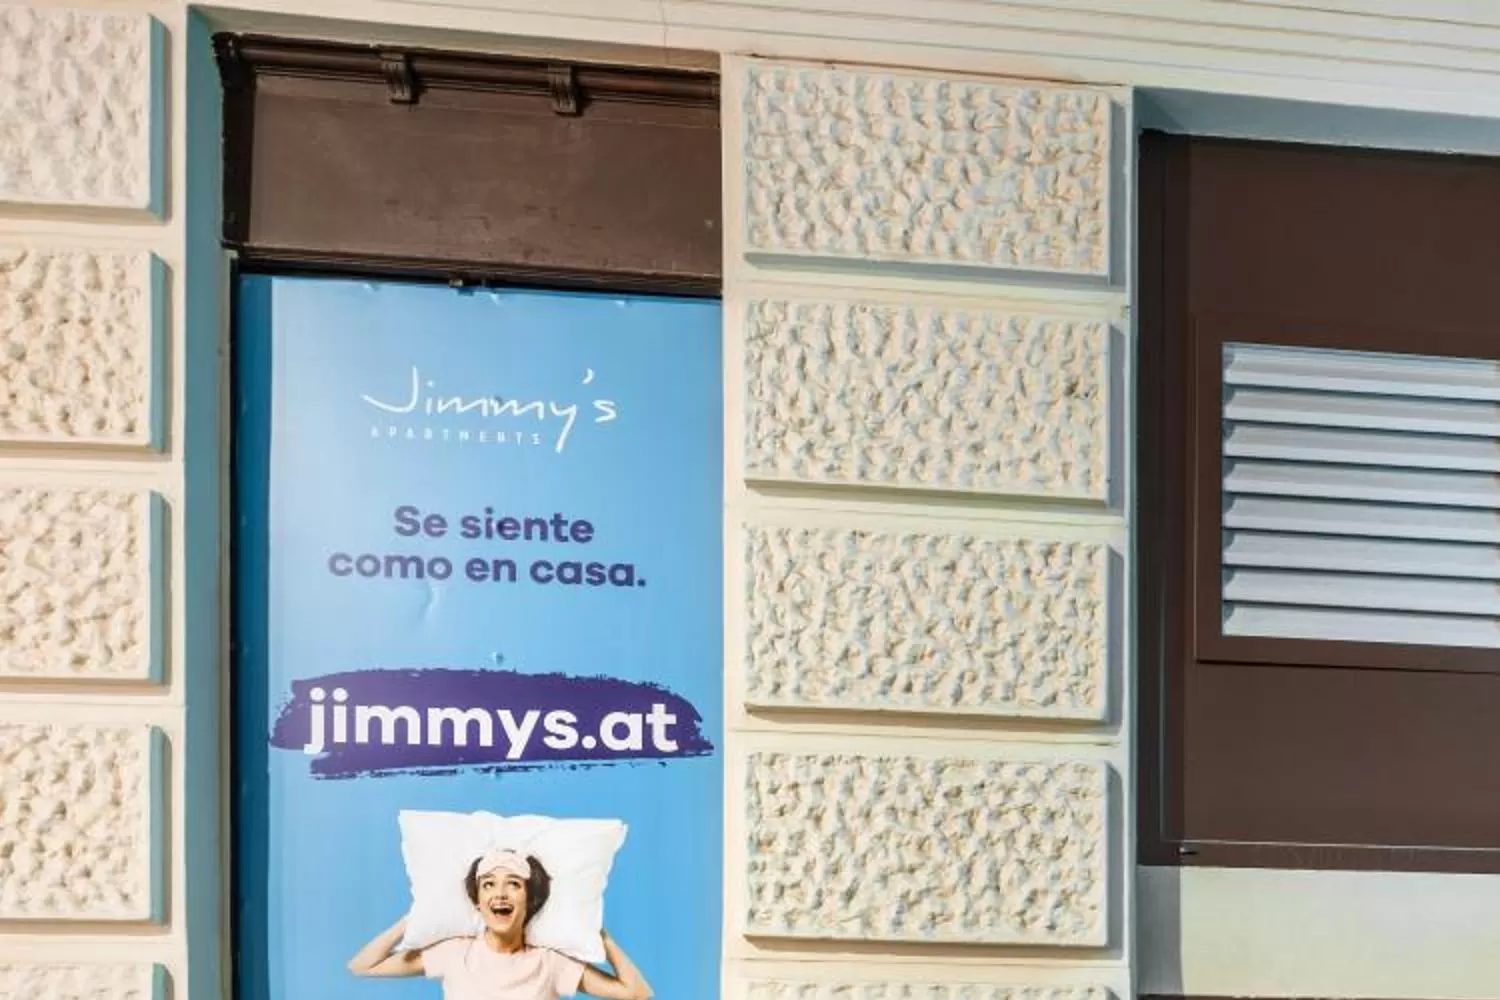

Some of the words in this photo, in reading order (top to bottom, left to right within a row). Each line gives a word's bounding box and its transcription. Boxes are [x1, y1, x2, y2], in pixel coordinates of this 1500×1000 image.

[359, 365, 617, 453] Jimmy's
[370, 425, 541, 445] APARTMENTS
[394, 504, 448, 537] Se
[460, 507, 595, 543] siente
[328, 552, 453, 580] como
[465, 558, 517, 583] en
[529, 559, 647, 588] casa.
[304, 687, 679, 760] jimmys.at
